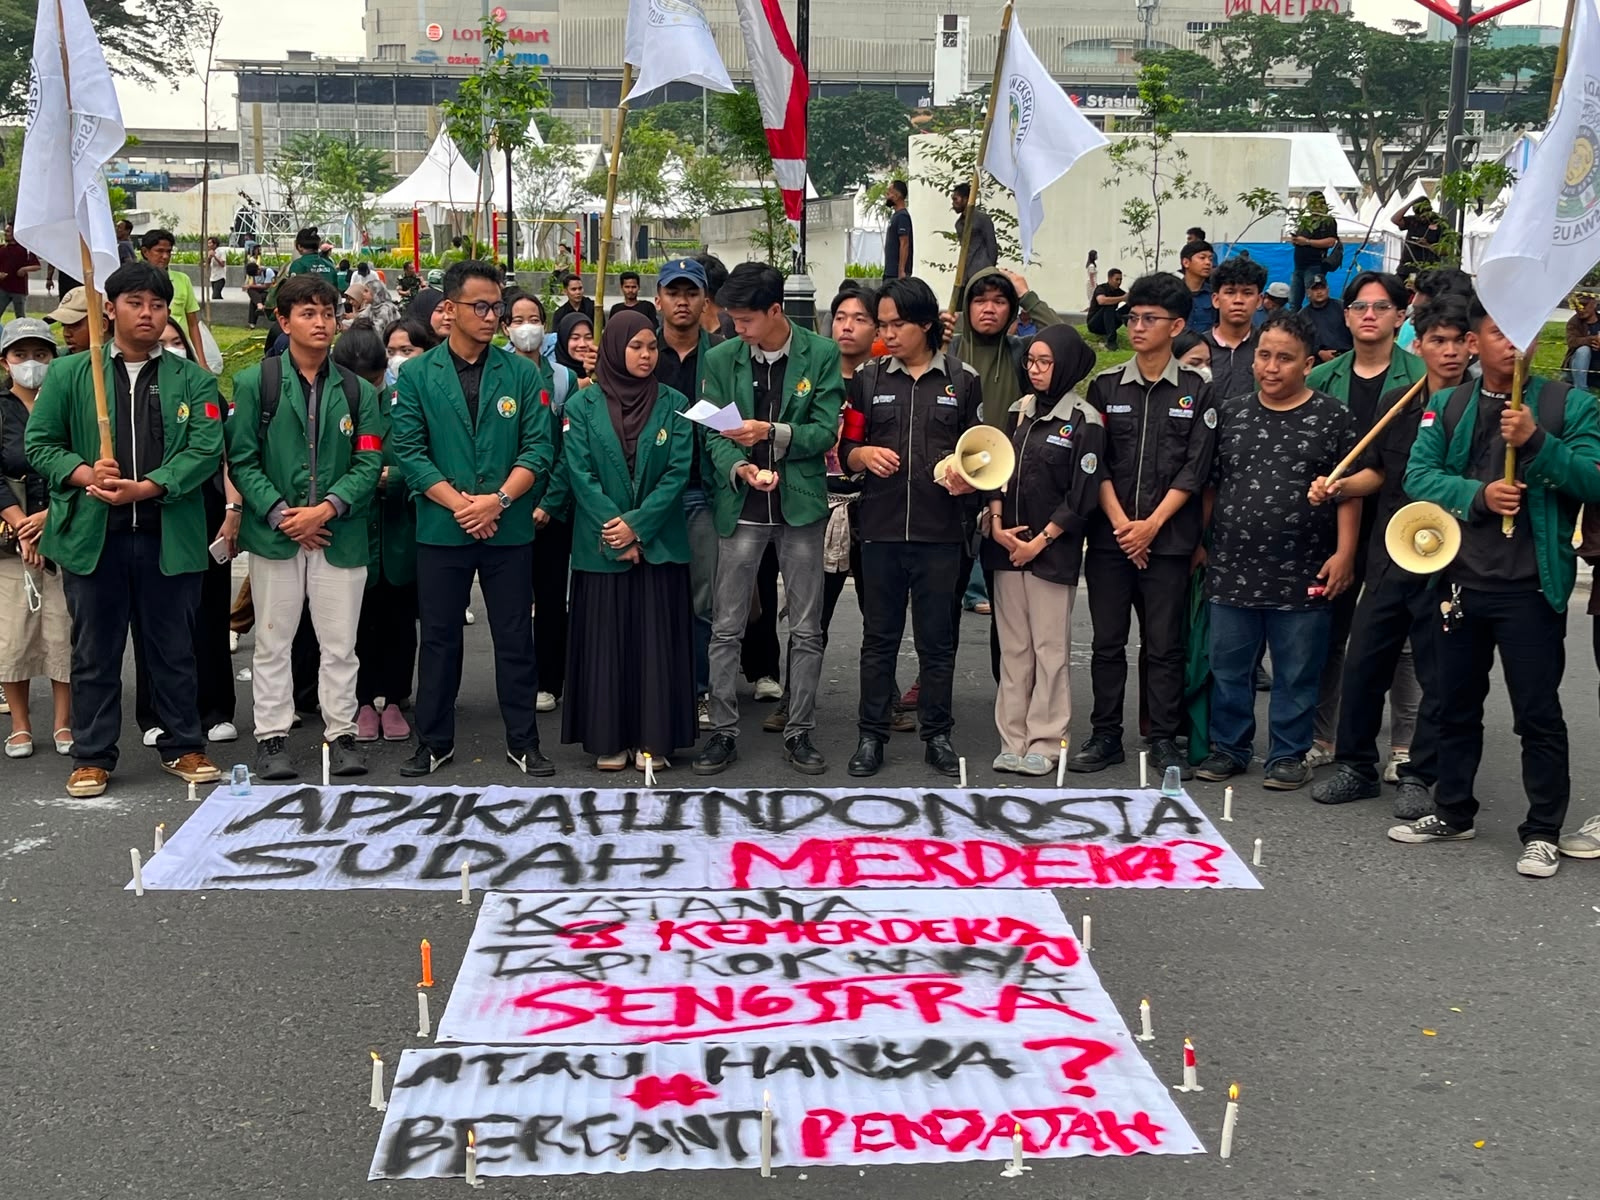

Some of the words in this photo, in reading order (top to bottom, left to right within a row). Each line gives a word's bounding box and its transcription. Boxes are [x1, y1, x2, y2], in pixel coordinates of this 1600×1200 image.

[508, 28, 549, 43] Mart
[221, 787, 640, 837] APAKAH
[211, 837, 685, 887] SUDAH
[729, 835, 1226, 889] MERDEKA?
[474, 944, 652, 982] TAPI
[678, 947, 836, 981] KOK
[509, 972, 1102, 1040] SENGSARA
[394, 1048, 648, 1090] ATAU
[704, 1039, 1018, 1085] HANYA
[1021, 1036, 1117, 1099] ?
